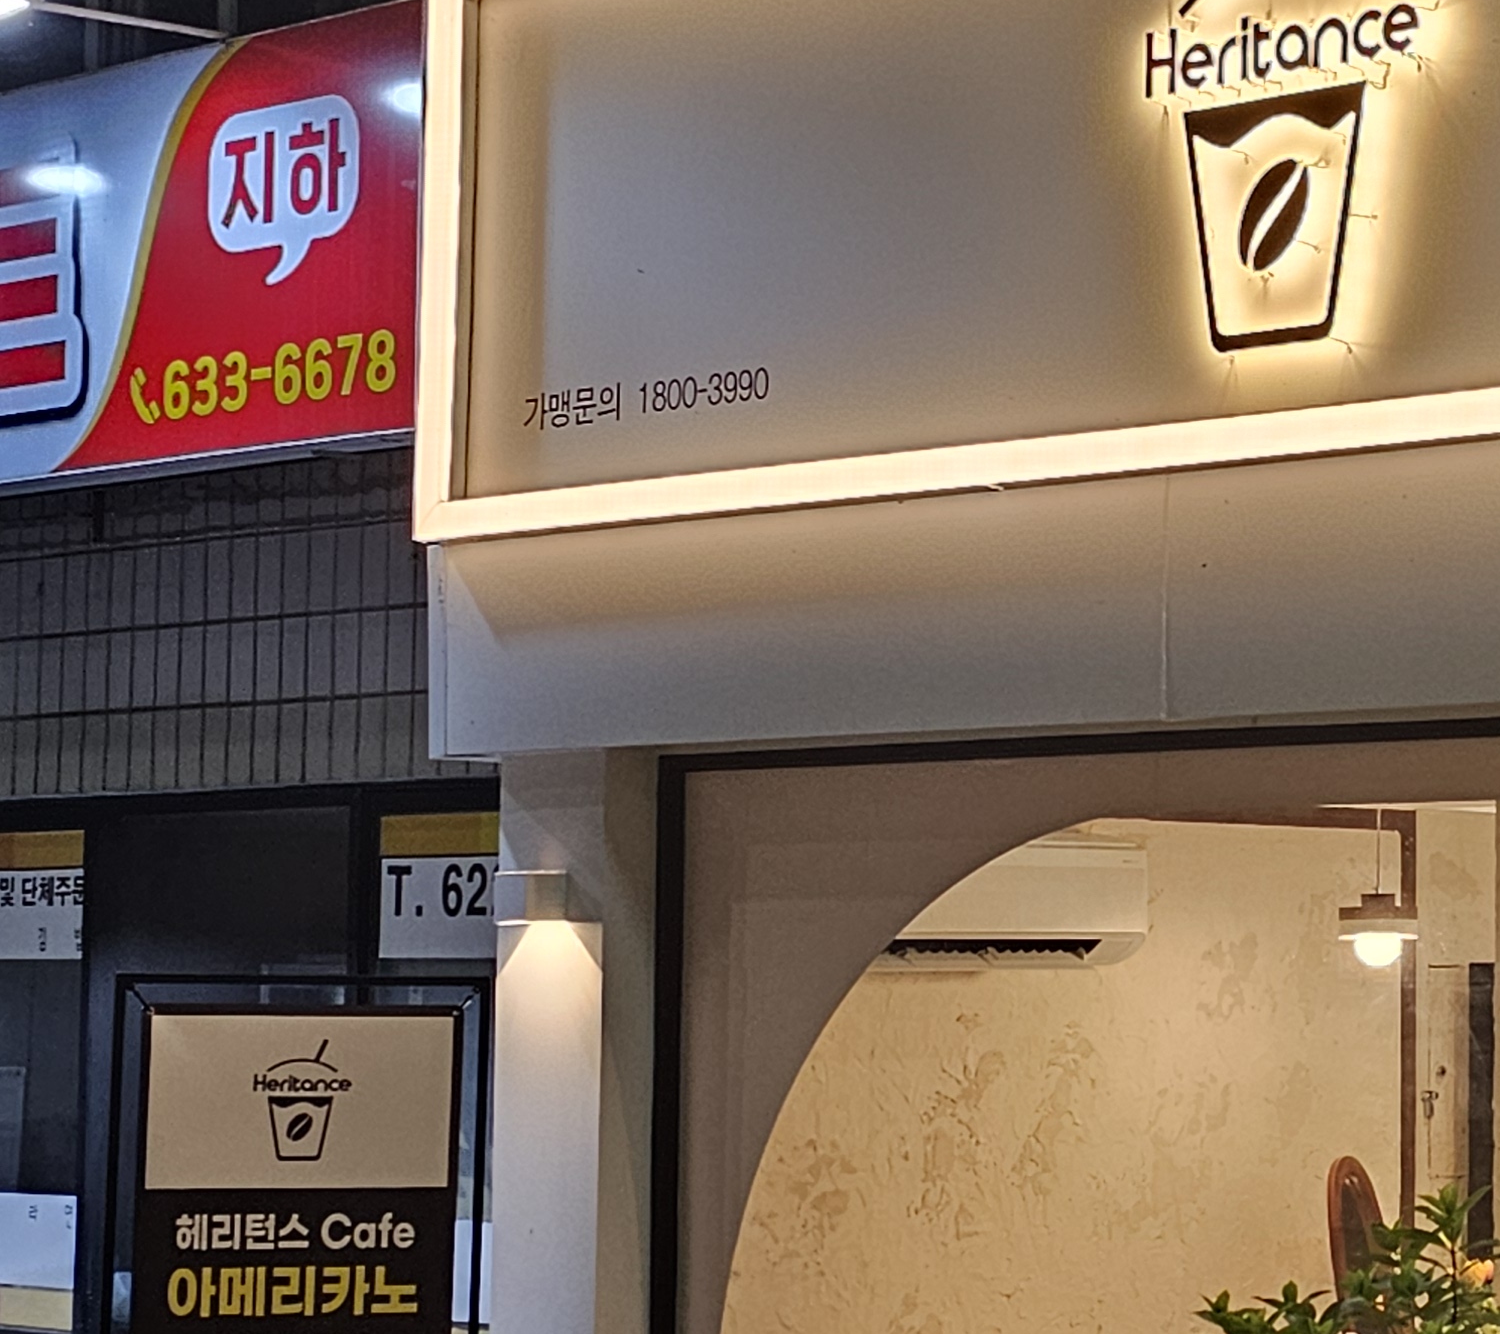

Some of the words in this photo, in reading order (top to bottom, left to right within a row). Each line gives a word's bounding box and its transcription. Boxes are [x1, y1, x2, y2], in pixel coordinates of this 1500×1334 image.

[1144, 2, 1420, 99] Heritance
[220, 117, 347, 230] 지하
[162, 328, 397, 421] 633-6678
[522, 381, 621, 431] 가맹문의
[639, 366, 770, 415] 1800-3990
[442, 863, 500, 918] 62
[252, 1072, 353, 1093] Heritance
[175, 1212, 311, 1252] 헤리턴스
[319, 1212, 417, 1251] Cafe
[166, 1265, 419, 1319] 아메리카노
